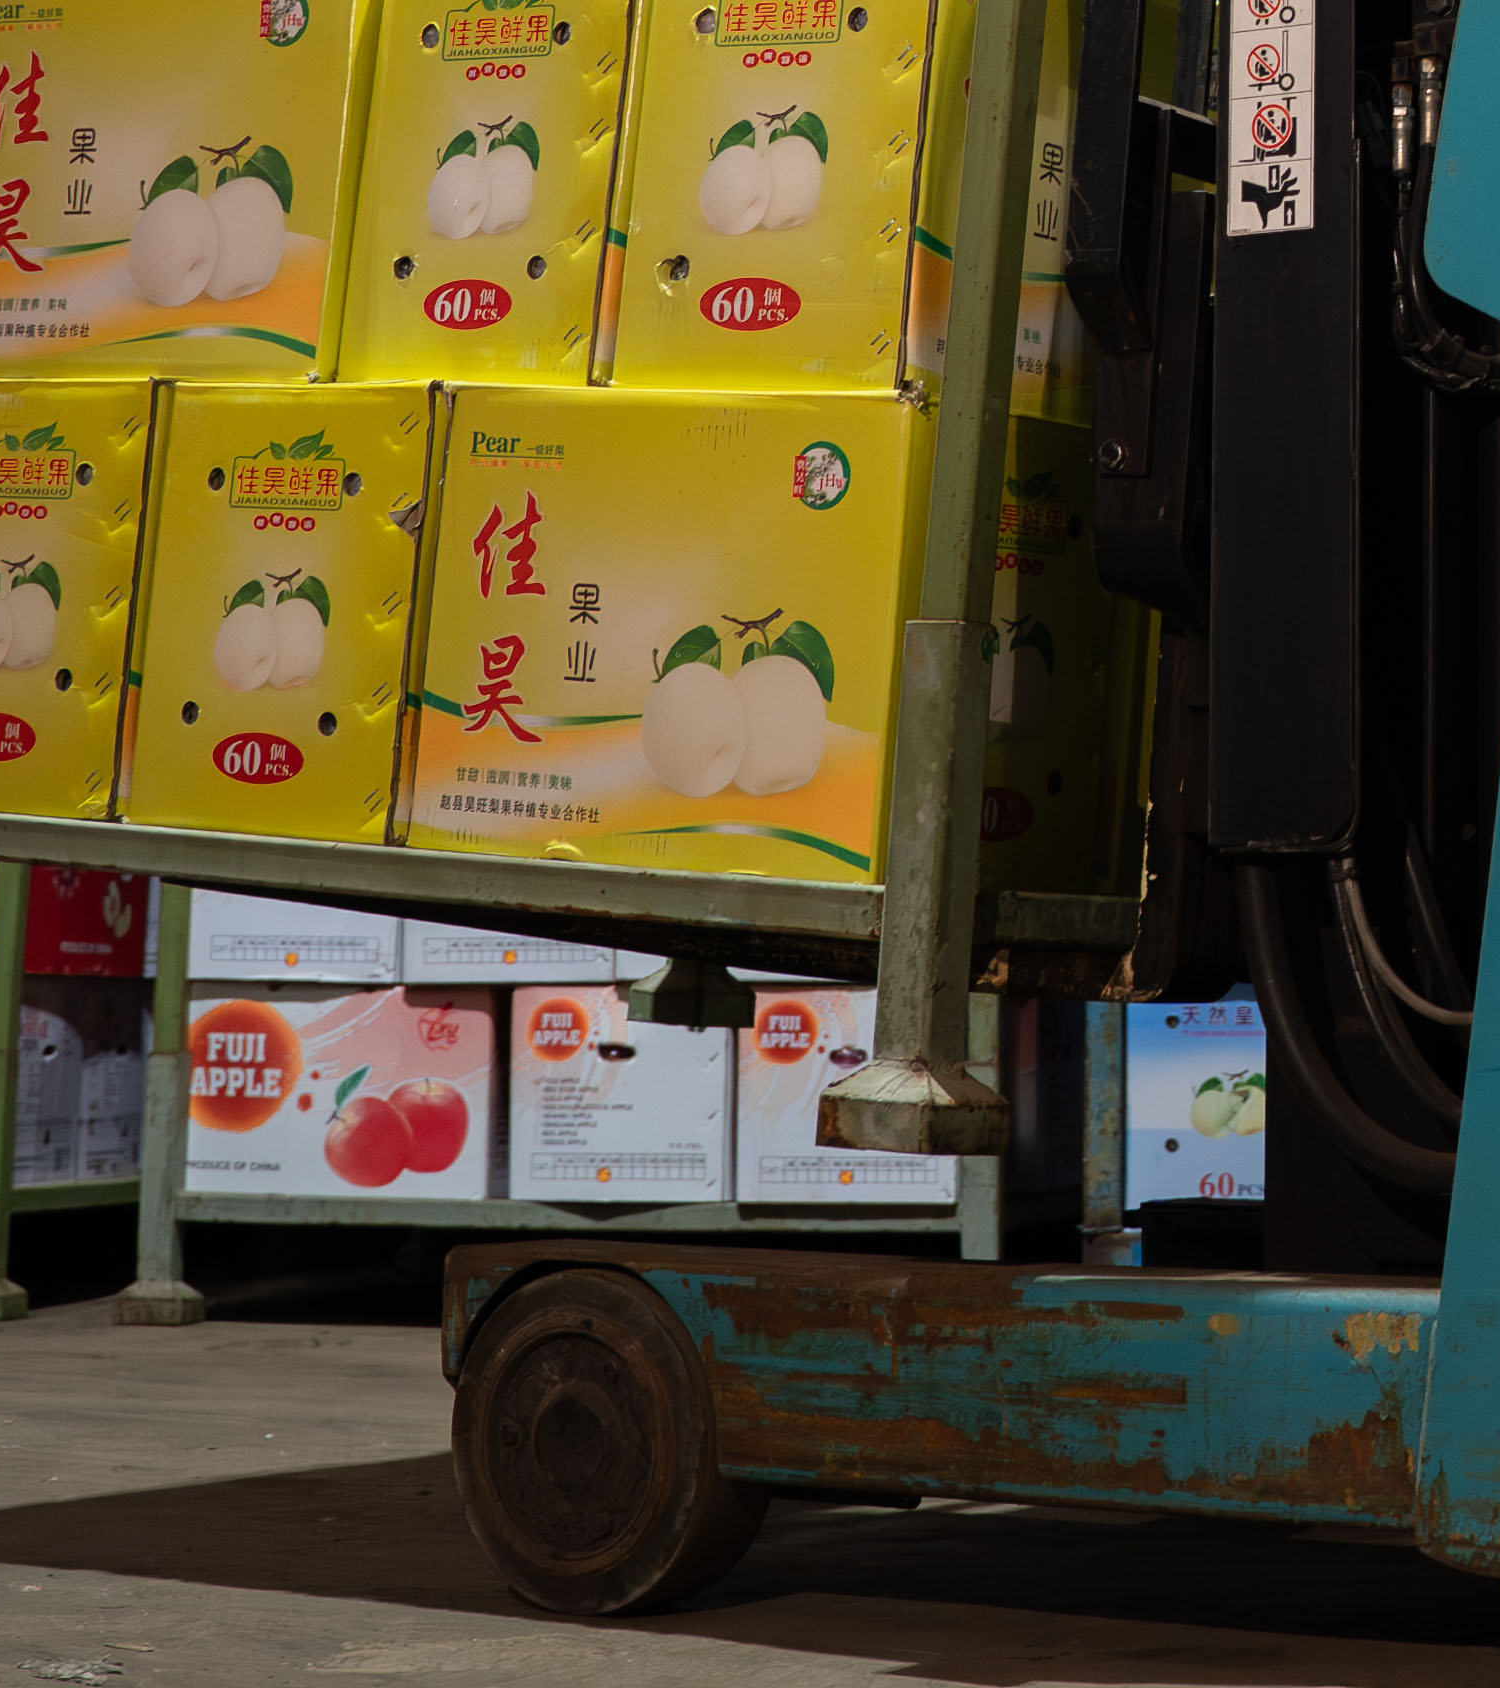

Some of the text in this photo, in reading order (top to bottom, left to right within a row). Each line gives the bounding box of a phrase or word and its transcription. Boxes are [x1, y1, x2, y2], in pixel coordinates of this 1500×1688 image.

[724, 0, 837, 33] 佳昊鲜果
[449, 14, 549, 47] 佳昊鲜果
[719, 30, 836, 46] JIAHAOXIANGUO
[446, 44, 549, 60] JIAHAOXIANGUO
[63, 128, 97, 216] 果业
[1033, 141, 1064, 241] 果业
[433, 288, 472, 322] 60
[479, 287, 496, 306] 個
[711, 286, 755, 323] 60
[764, 286, 782, 307] 個
[473, 306, 502, 321] PCS.
[757, 307, 789, 323] PCS.
[470, 430, 522, 455] Pear
[236, 466, 340, 497] 佳昊鲜果
[234, 496, 338, 508] JIAHAOXIANGUO
[462, 490, 547, 744] 佳昊
[563, 582, 602, 684] 果业
[0, 741, 27, 755] PCS.
[223, 740, 262, 776] 60
[269, 744, 287, 762] 個
[264, 763, 294, 778] PCS.
[439, 794, 601, 825] 赵县昊旺梨果种植专业合作社
[541, 1012, 573, 1029] FUJI
[768, 1014, 801, 1031] FUJI
[206, 1032, 267, 1063] FUJI
[530, 1025, 583, 1049] APPLE
[757, 1028, 812, 1051] APPLE
[190, 1066, 283, 1099] APPLE
[1199, 1172, 1234, 1197] 60
